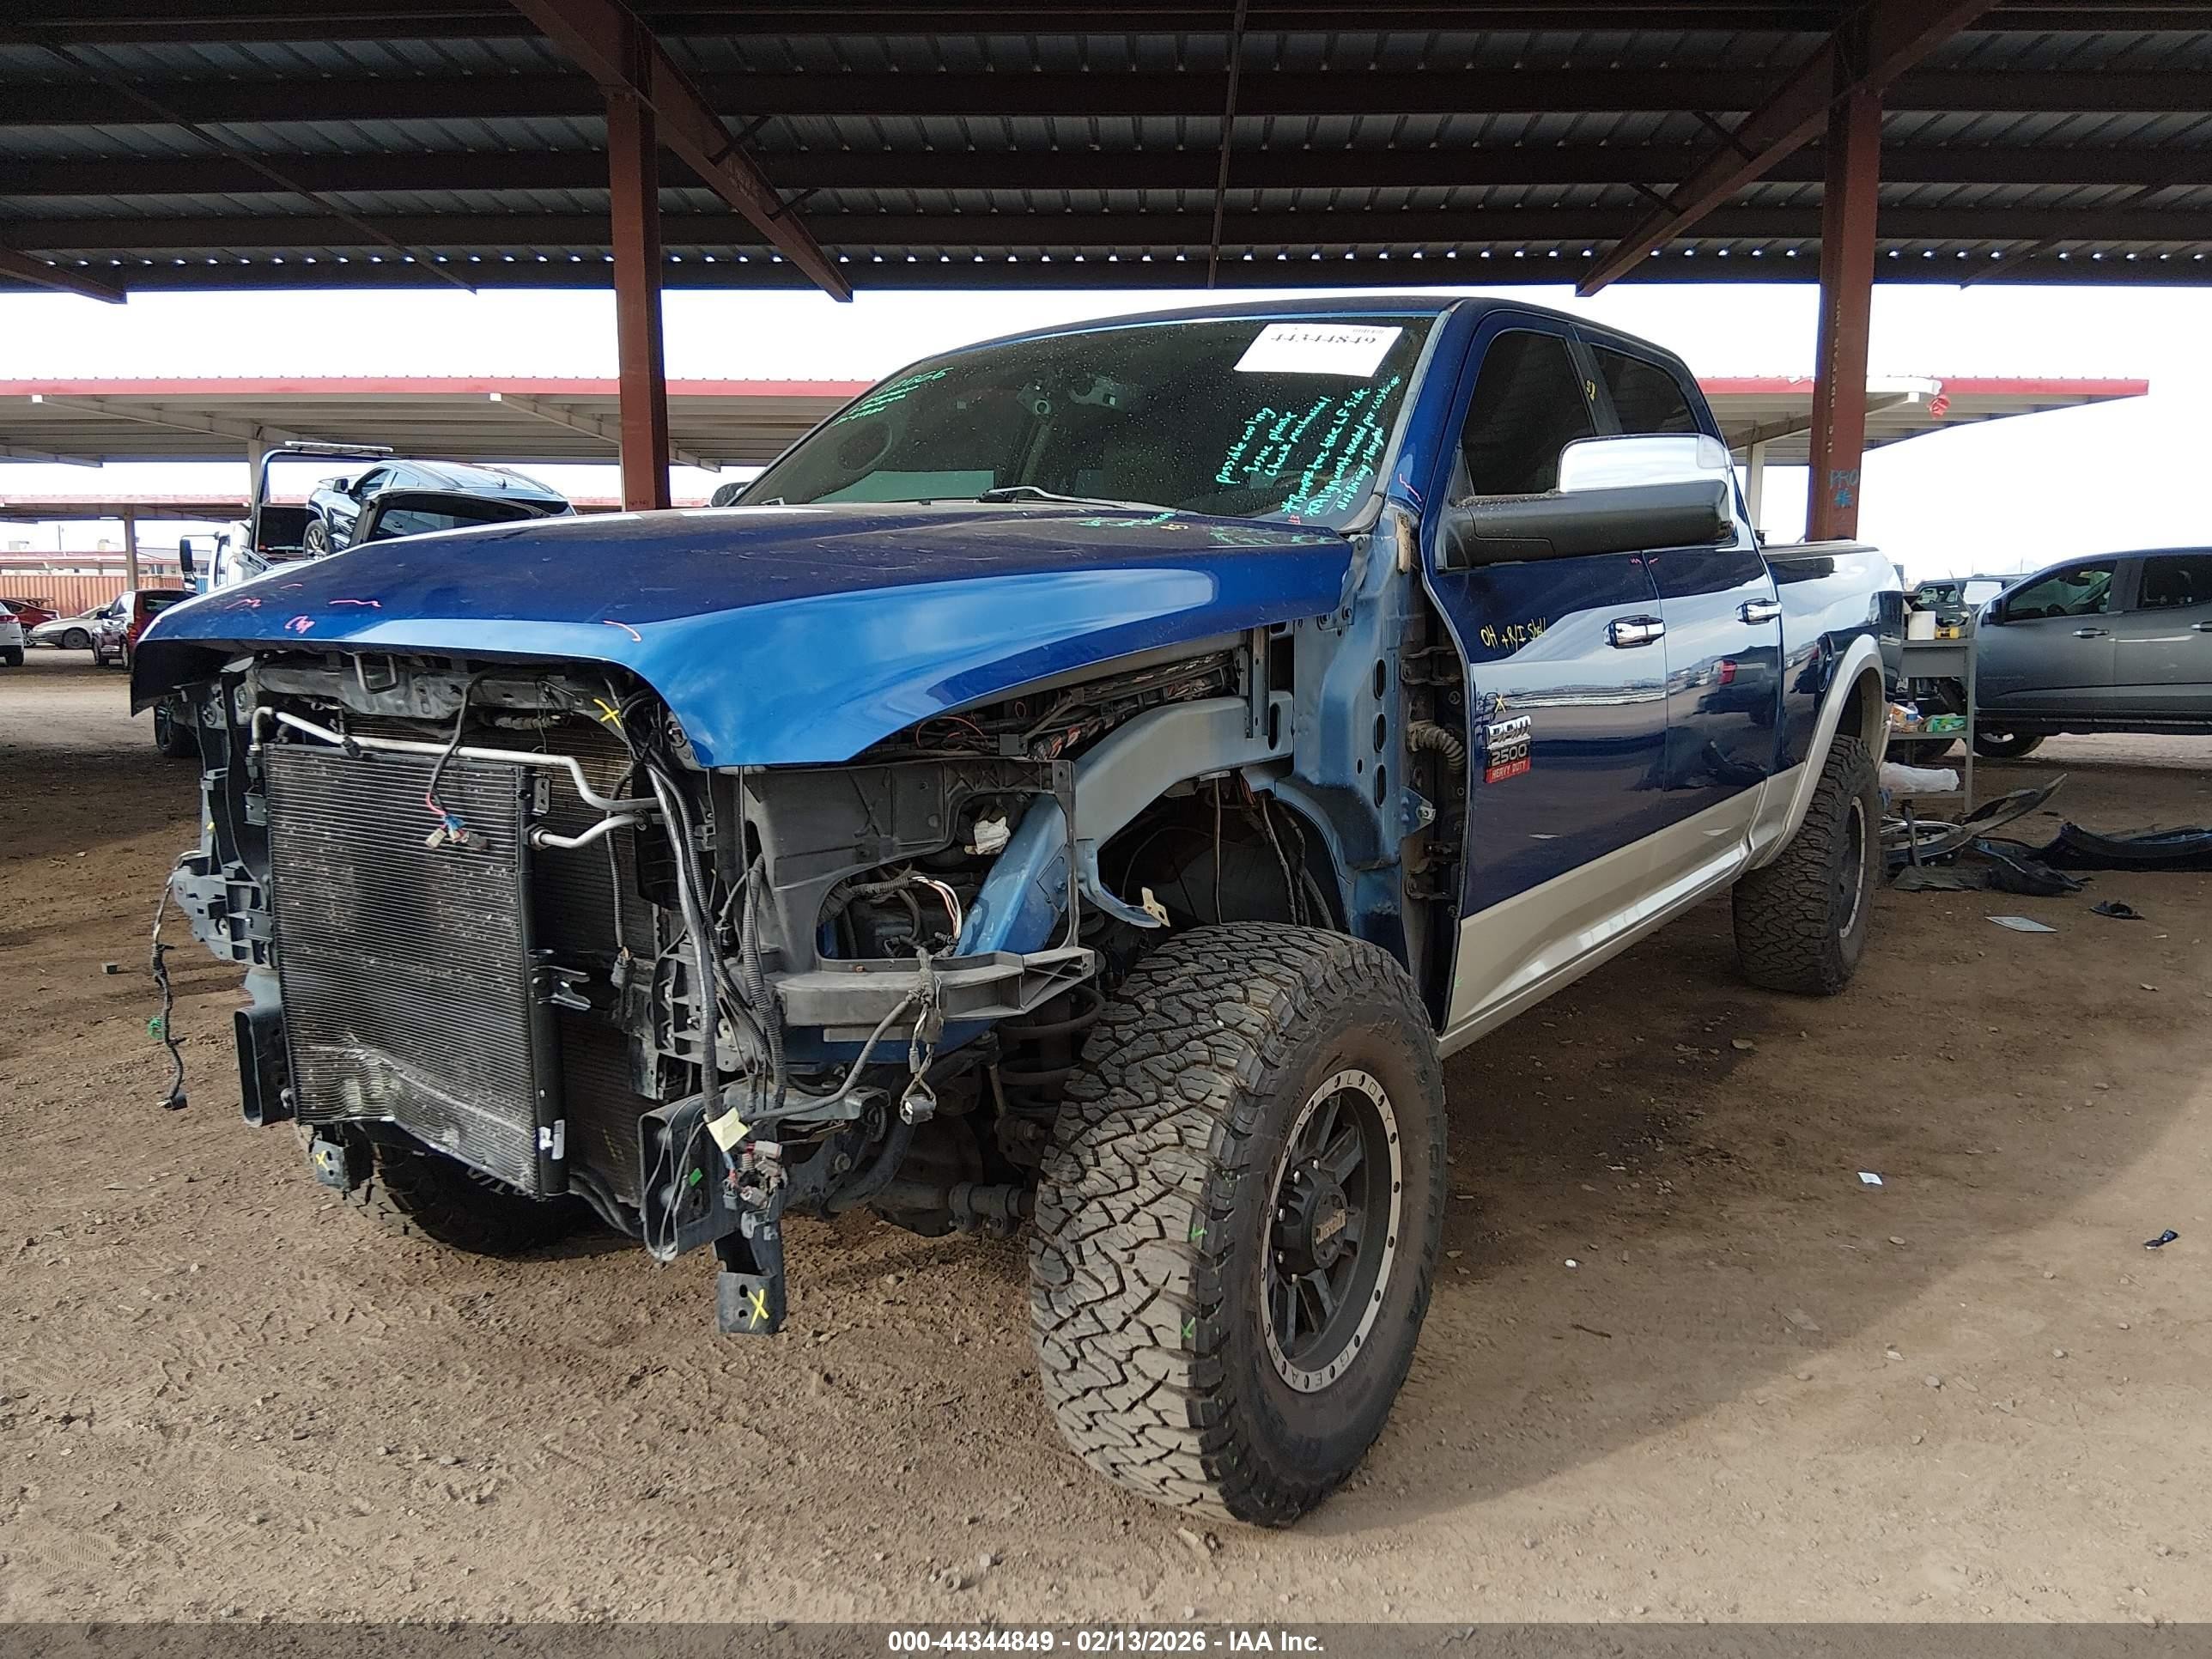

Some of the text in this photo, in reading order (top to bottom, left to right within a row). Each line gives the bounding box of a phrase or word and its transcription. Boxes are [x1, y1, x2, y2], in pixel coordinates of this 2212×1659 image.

[1242, 407, 1277, 441] cooling
[1492, 743, 1528, 767] 2500
[1492, 759, 1528, 781] HEAVY DUTY
